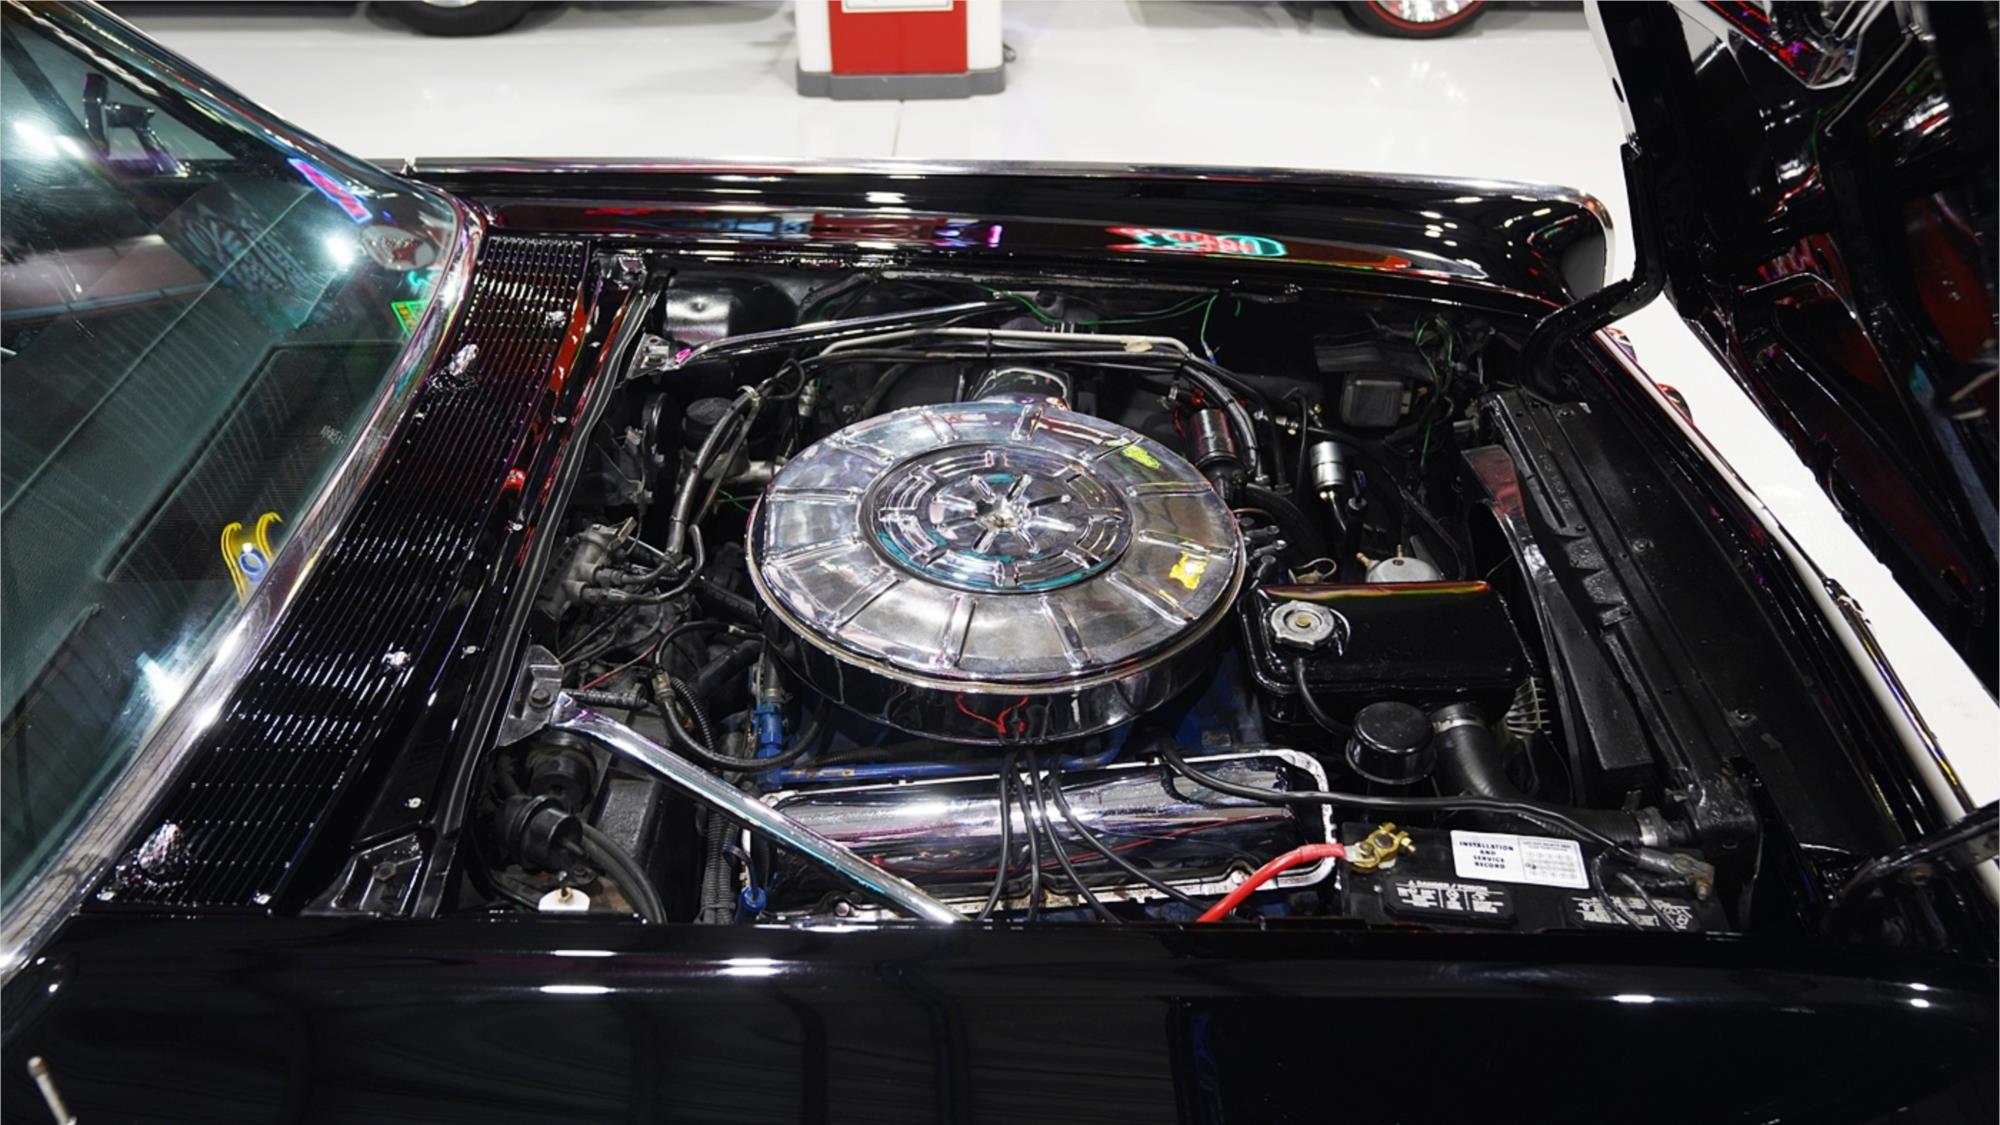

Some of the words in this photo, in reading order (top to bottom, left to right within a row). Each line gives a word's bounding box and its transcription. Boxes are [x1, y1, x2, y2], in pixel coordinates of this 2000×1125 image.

[1459, 841, 1514, 851] INSTALLATION
[1473, 855, 1505, 863] SERVICE
[1474, 861, 1506, 869] RECORD
